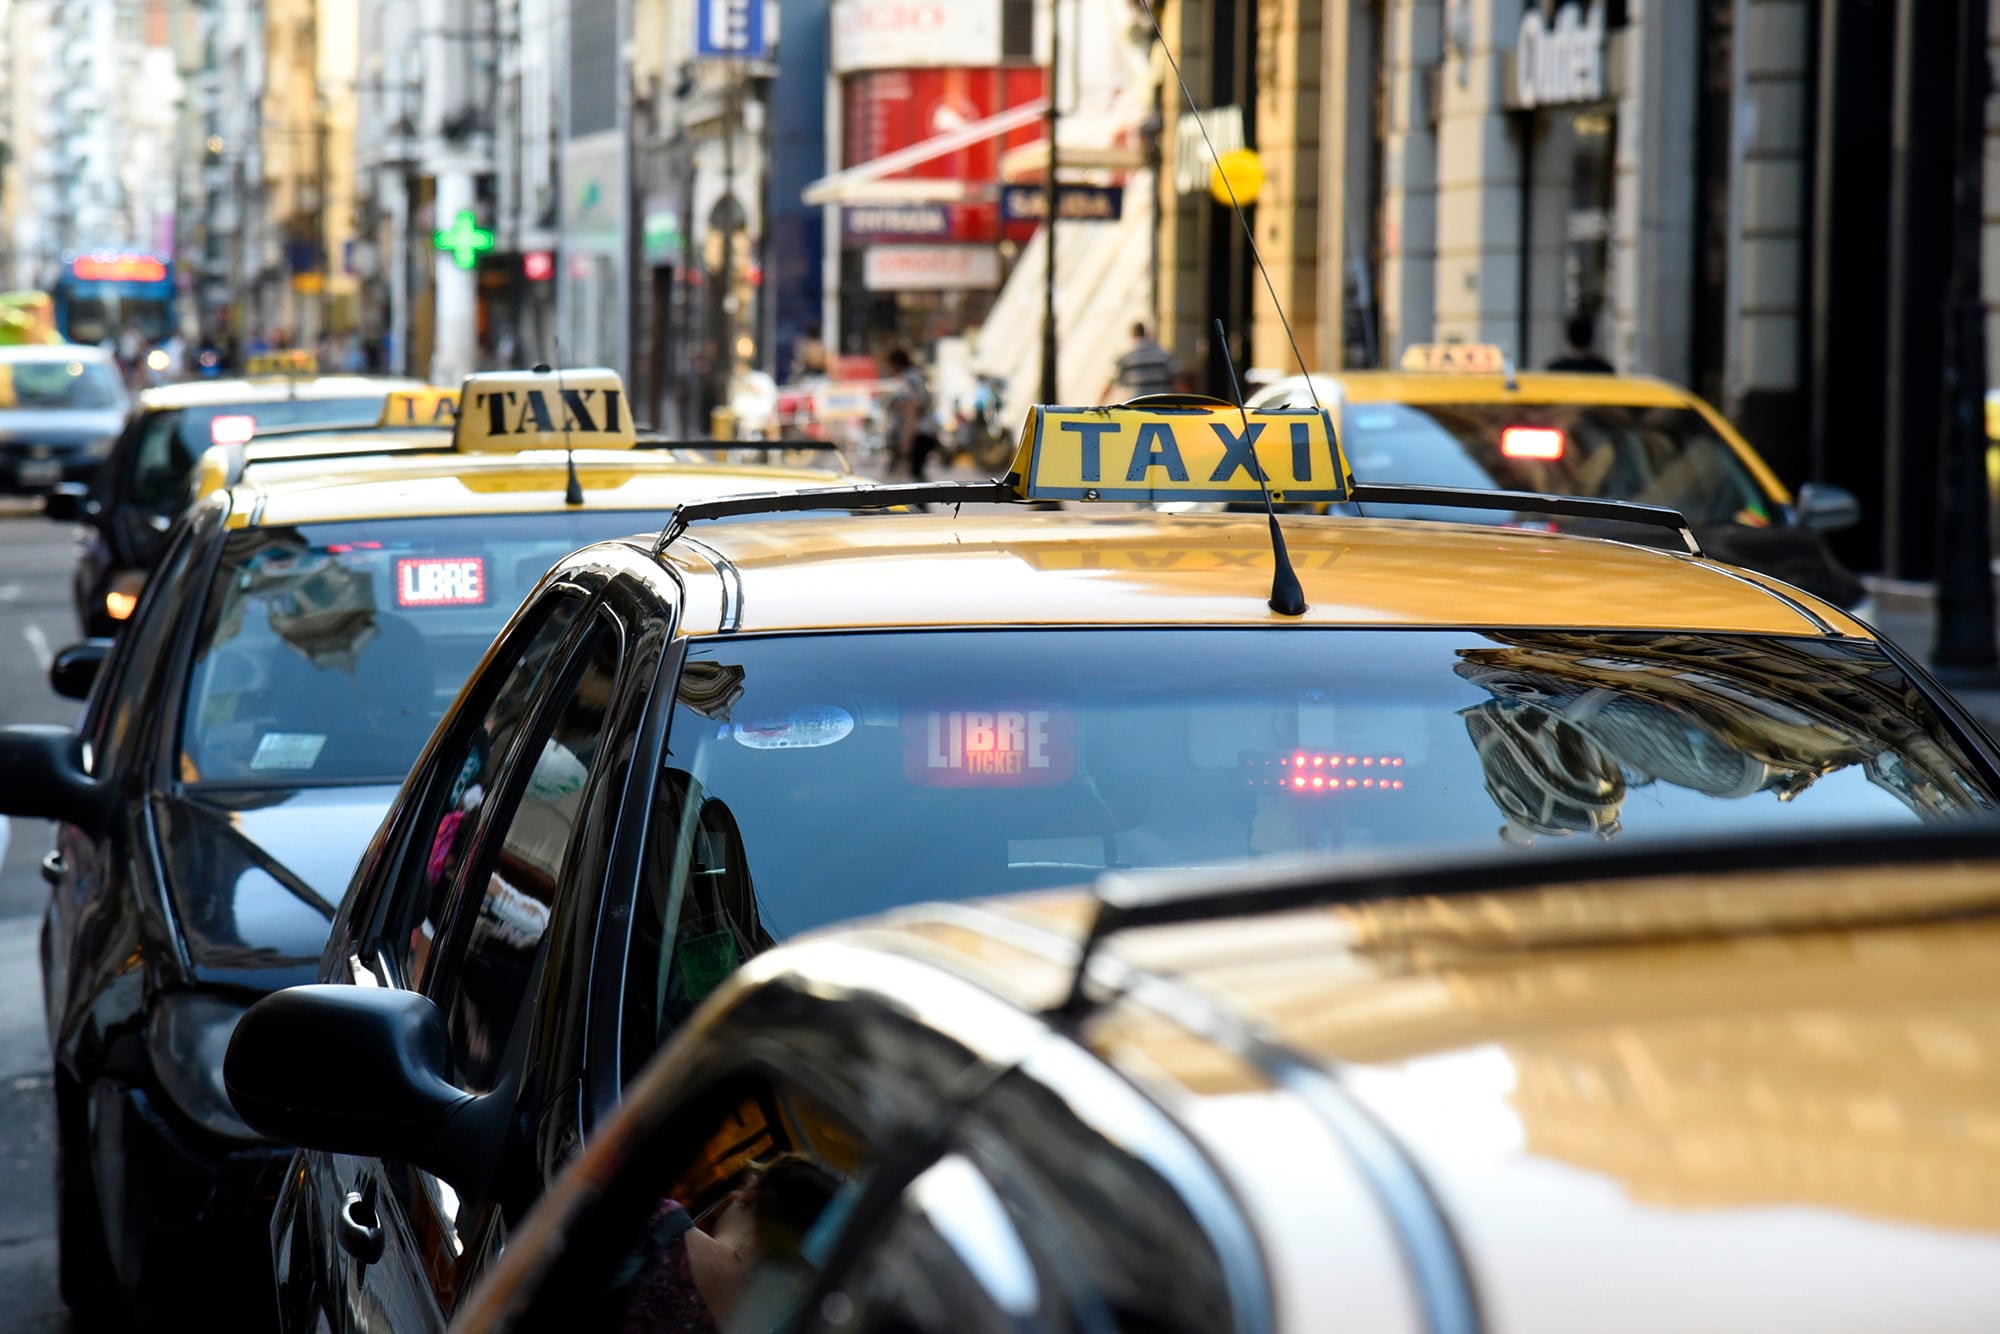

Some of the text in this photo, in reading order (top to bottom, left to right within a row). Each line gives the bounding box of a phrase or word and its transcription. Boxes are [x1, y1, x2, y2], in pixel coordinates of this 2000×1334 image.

[709, 0, 748, 49] E
[477, 389, 622, 436] TAXI
[1061, 421, 1312, 482] TAXI
[404, 562, 479, 600] LIBRE
[927, 710, 1049, 768] LIBRE
[966, 750, 1024, 775] TICKET
